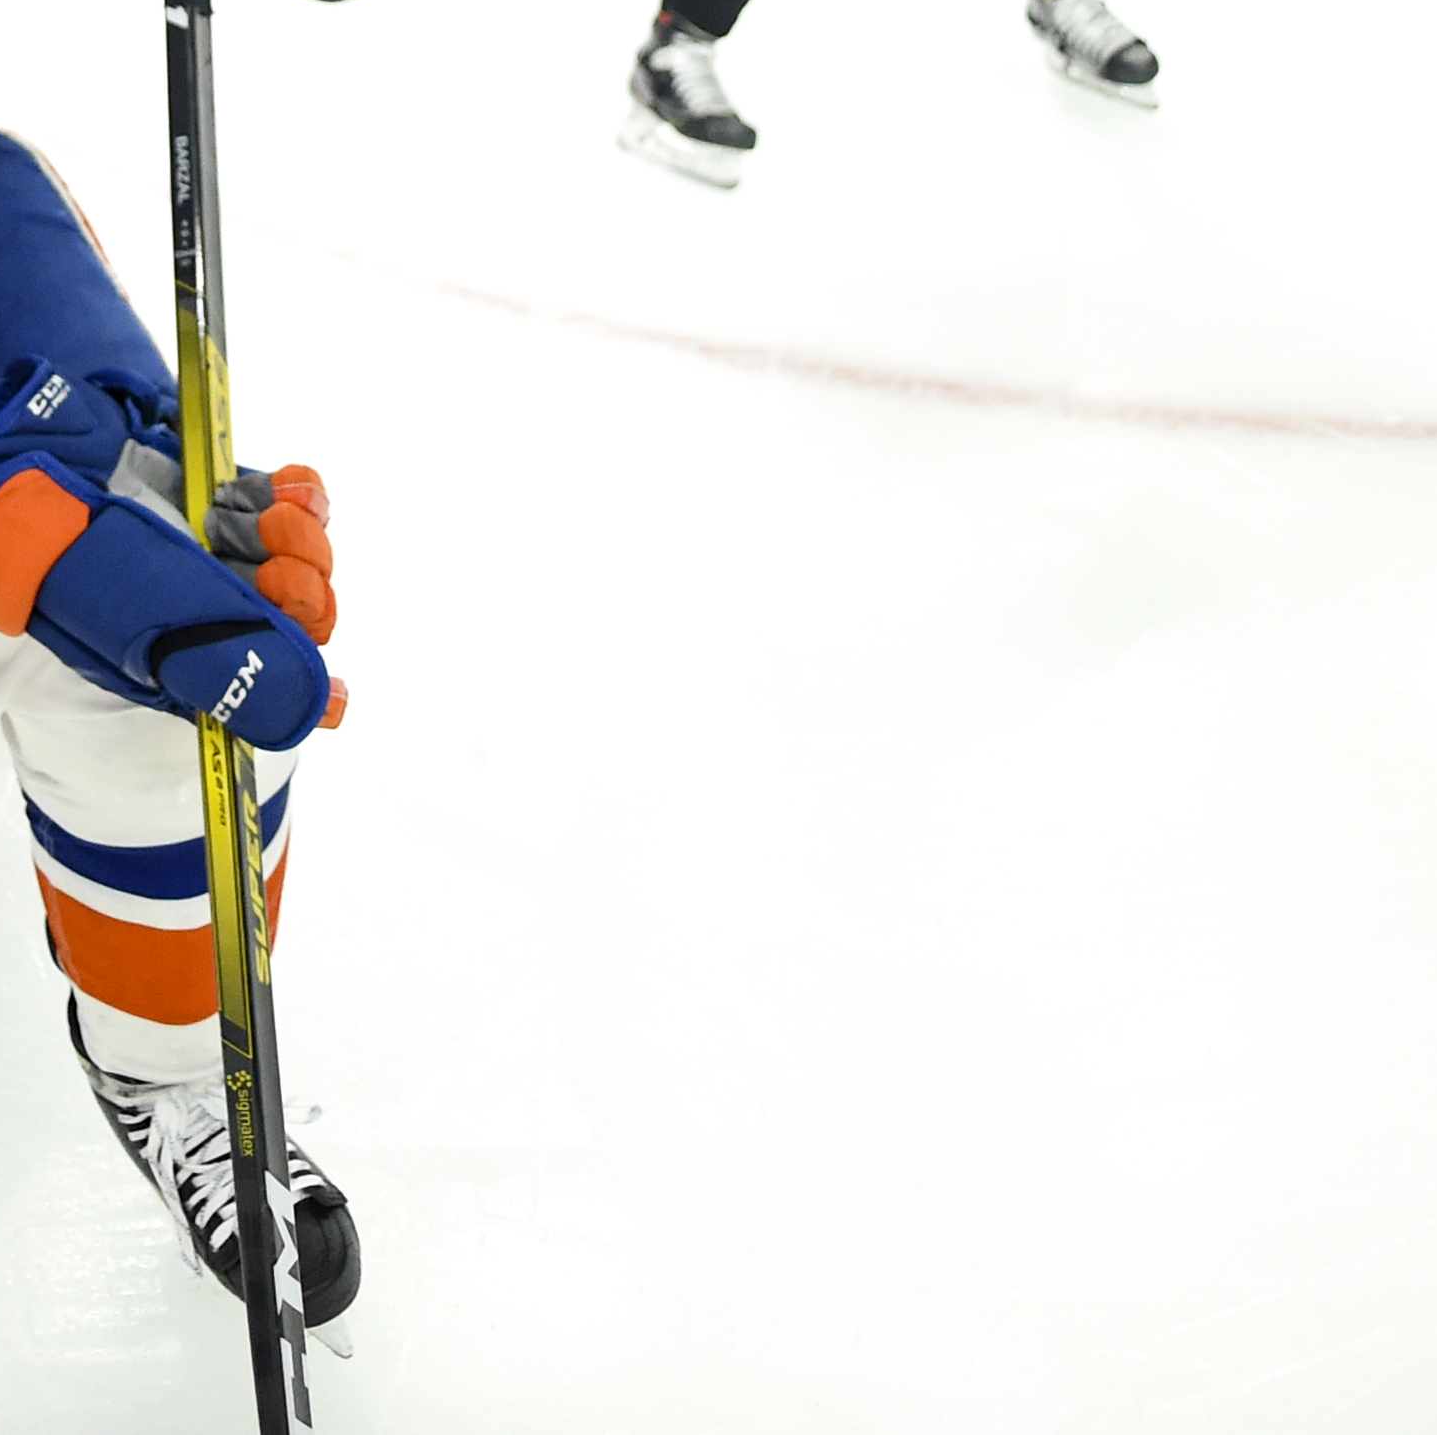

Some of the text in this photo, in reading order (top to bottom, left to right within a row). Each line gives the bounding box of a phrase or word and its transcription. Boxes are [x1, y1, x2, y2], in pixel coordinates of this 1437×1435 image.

[174, 134, 192, 206] BARZAL
[210, 649, 265, 724] CCM
[238, 796, 271, 985] SUPER
[234, 1087, 254, 1158] sigmatex
